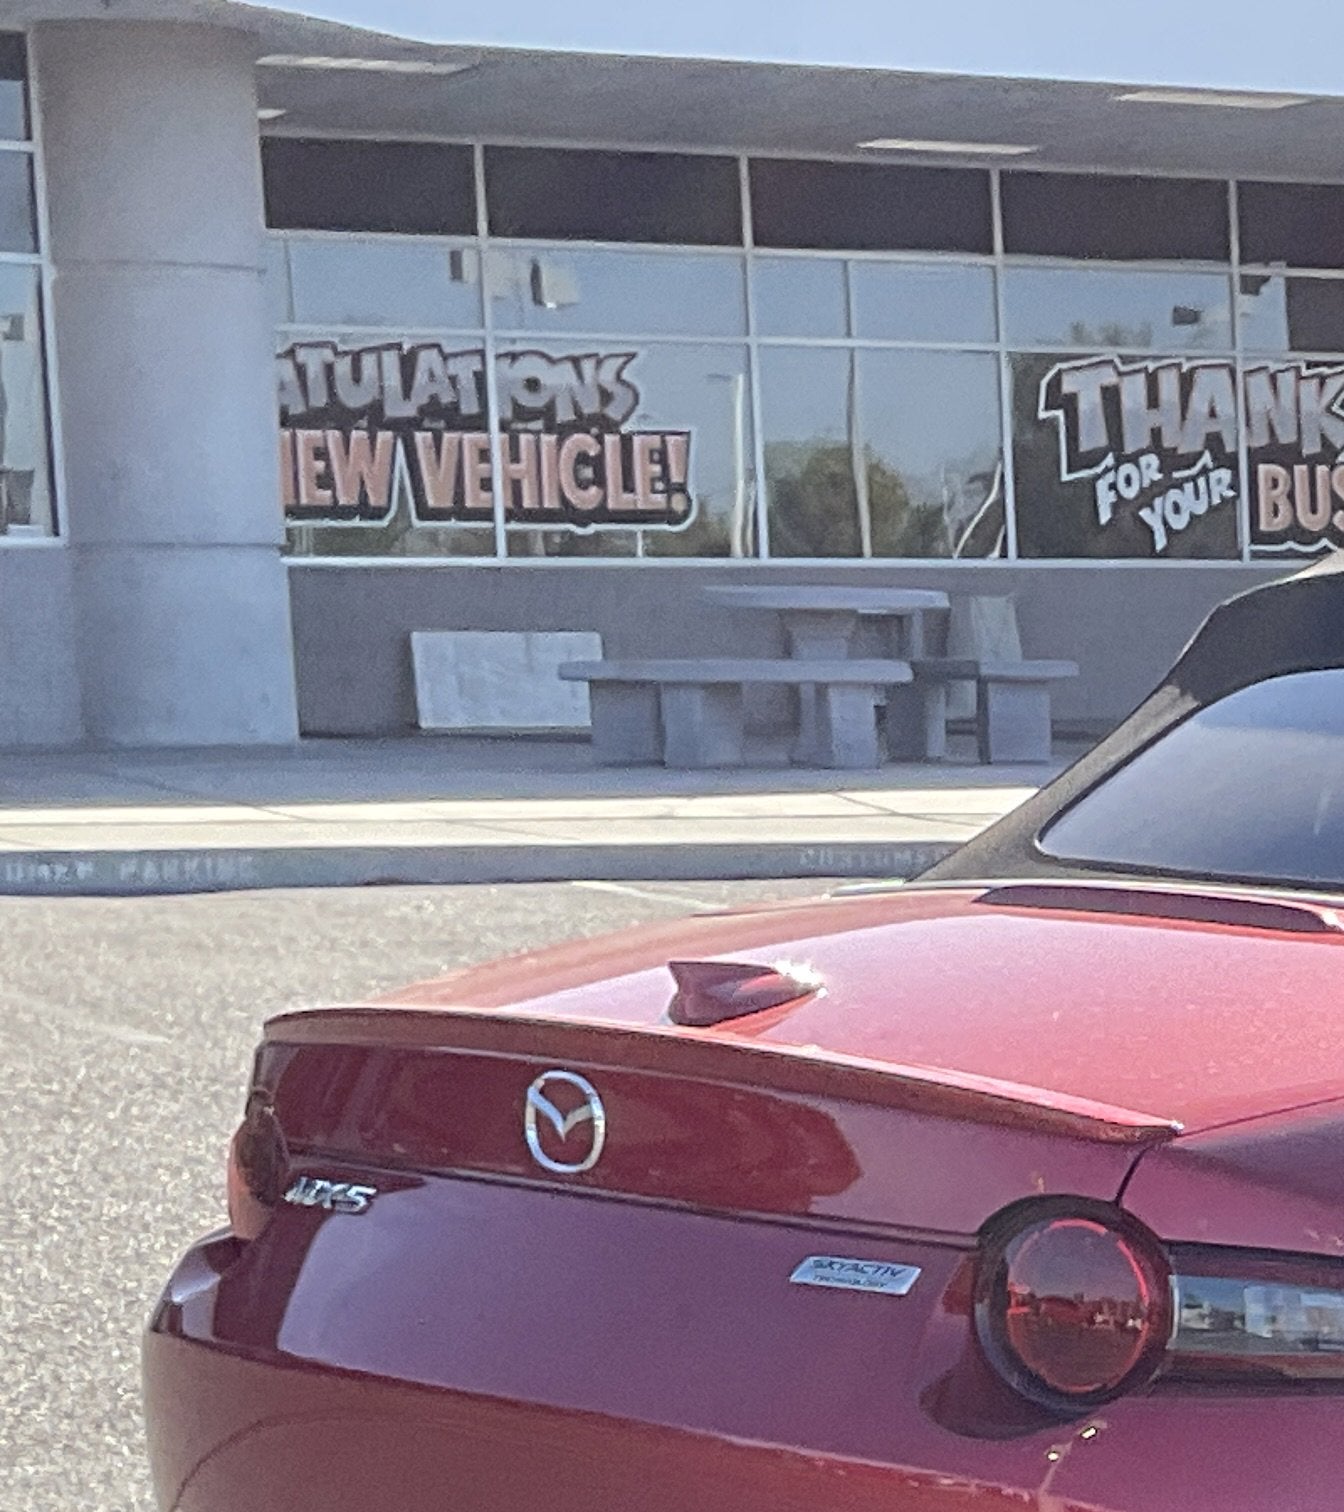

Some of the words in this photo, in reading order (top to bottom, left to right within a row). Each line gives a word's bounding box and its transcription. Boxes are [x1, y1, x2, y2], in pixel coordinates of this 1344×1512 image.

[413, 431, 690, 515] VEHICLE!
[1096, 452, 1163, 525] FOR
[1138, 467, 1237, 553] YOUR
[813, 1259, 906, 1277] SKYACTIV
